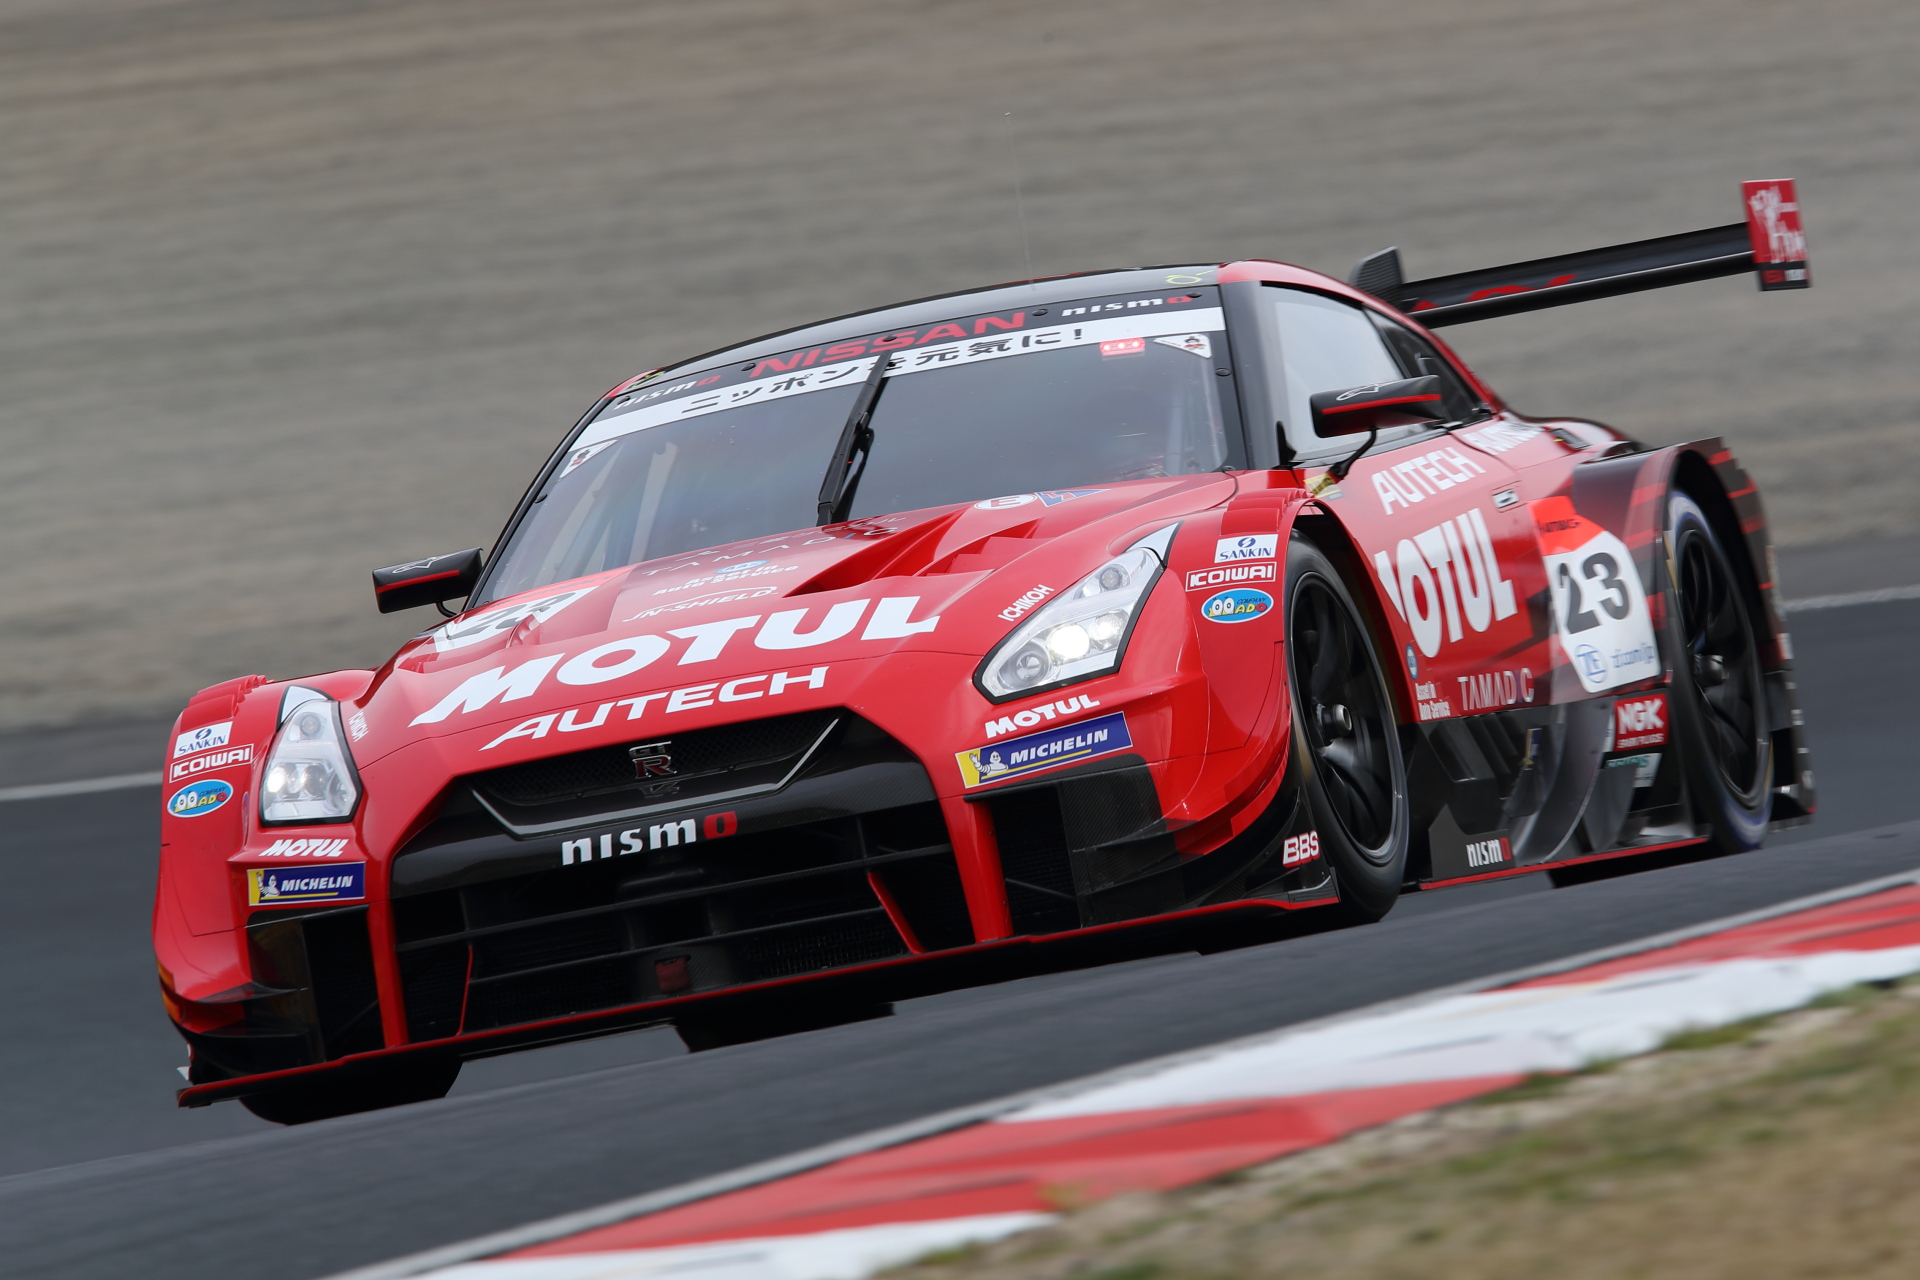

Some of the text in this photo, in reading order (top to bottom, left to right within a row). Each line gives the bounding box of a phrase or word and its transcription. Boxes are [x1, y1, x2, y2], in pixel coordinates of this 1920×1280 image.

[1061, 295, 1193, 317] nismo
[750, 312, 1025, 378] NISSAN
[612, 374, 722, 411] nismo
[1371, 446, 1487, 516] AUTECH
[1219, 547, 1272, 561] SANKIN
[1190, 565, 1273, 588] KOIWAI
[1553, 552, 1631, 634] 23
[998, 584, 1055, 622] ICHIKOH
[410, 596, 940, 730] MOTUL
[1457, 668, 1535, 711] TAMADIC
[480, 667, 829, 750] AUTECH
[984, 694, 1100, 739] MOTUL
[1617, 698, 1665, 734] NGK
[173, 746, 251, 779] KOIWAI
[177, 735, 227, 755] SANKIN
[1010, 728, 1109, 765] MICHELIN
[258, 839, 348, 858] MOTUL
[562, 811, 738, 866] nismo
[1282, 830, 1320, 865] BBS
[281, 875, 353, 893] MICHELIN
